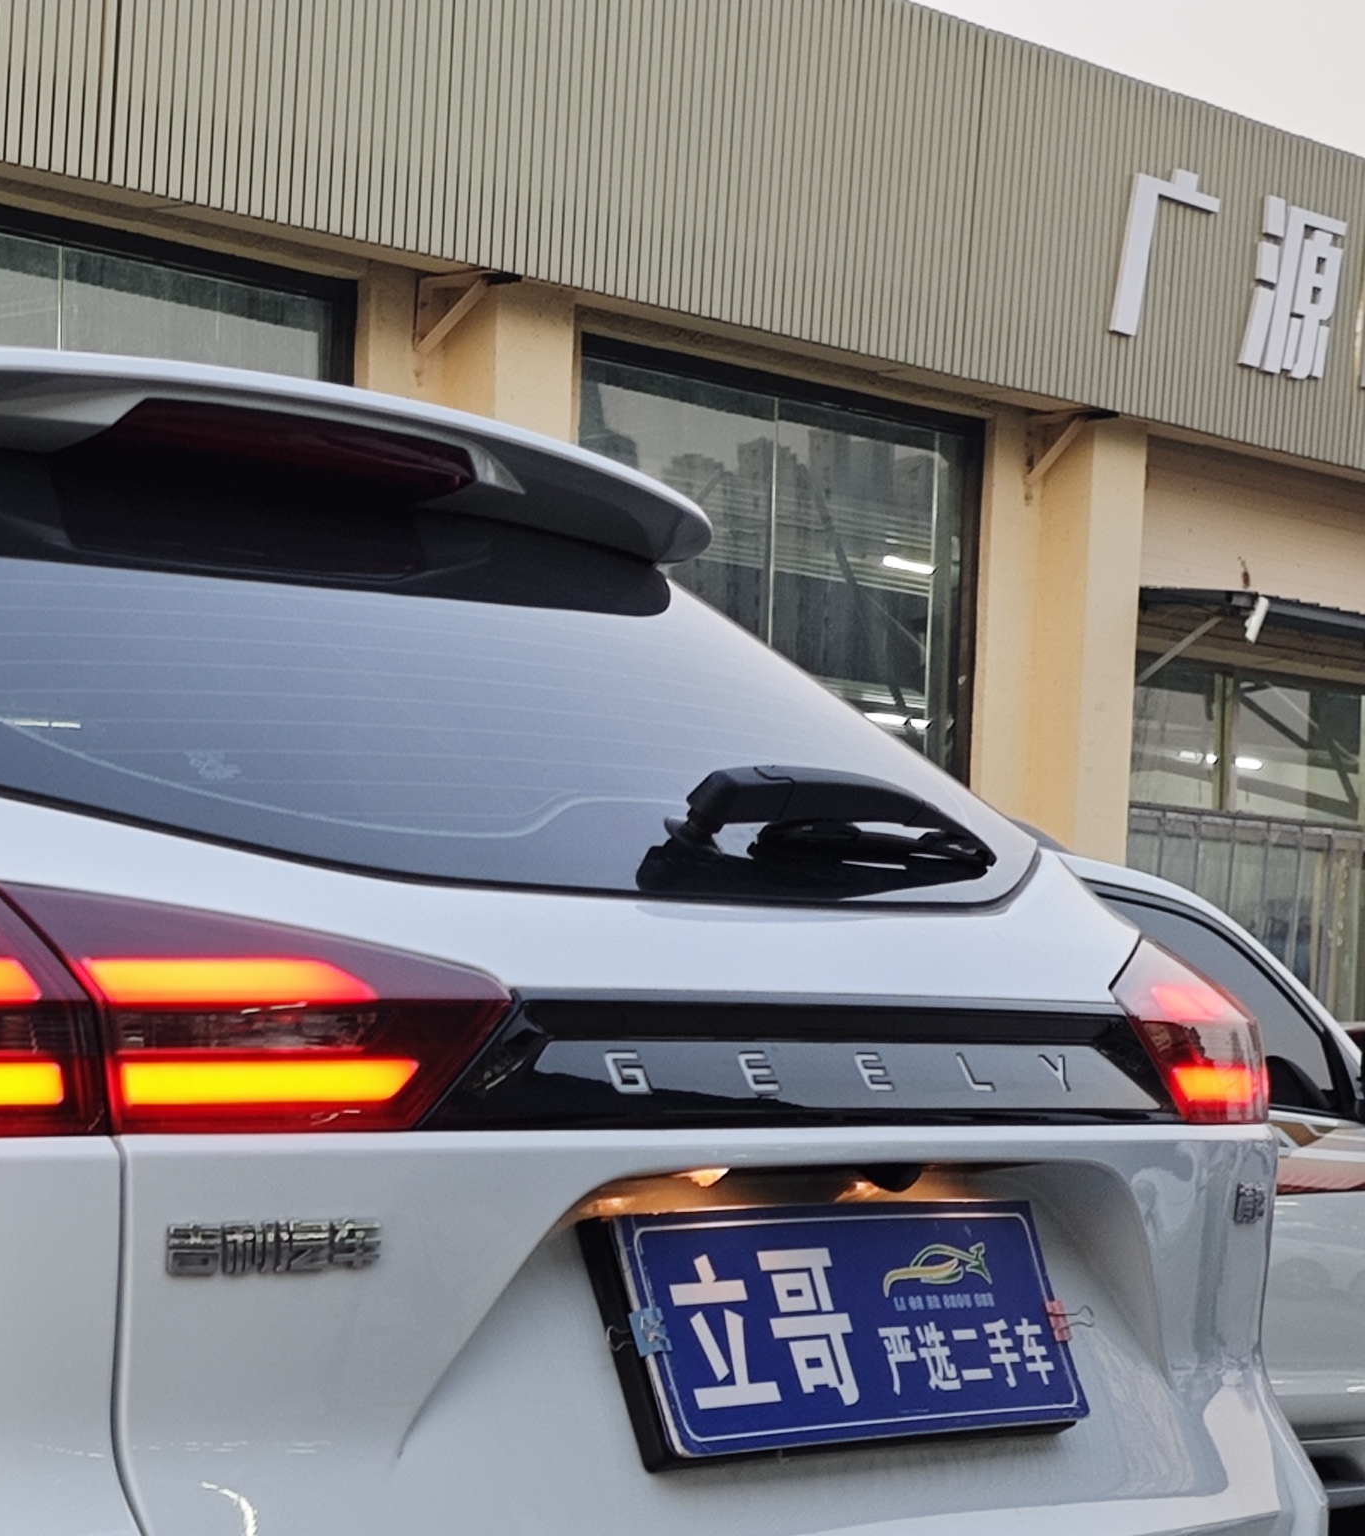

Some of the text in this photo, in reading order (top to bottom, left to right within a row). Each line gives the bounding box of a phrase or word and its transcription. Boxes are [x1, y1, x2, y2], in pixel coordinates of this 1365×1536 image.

[1109, 168, 1348, 381] 广源
[605, 1049, 1073, 1097] GEELY
[165, 1216, 383, 1277] 吉利汽车
[668, 1245, 861, 1408] 立哥
[877, 1316, 1057, 1395] 严选二手车
